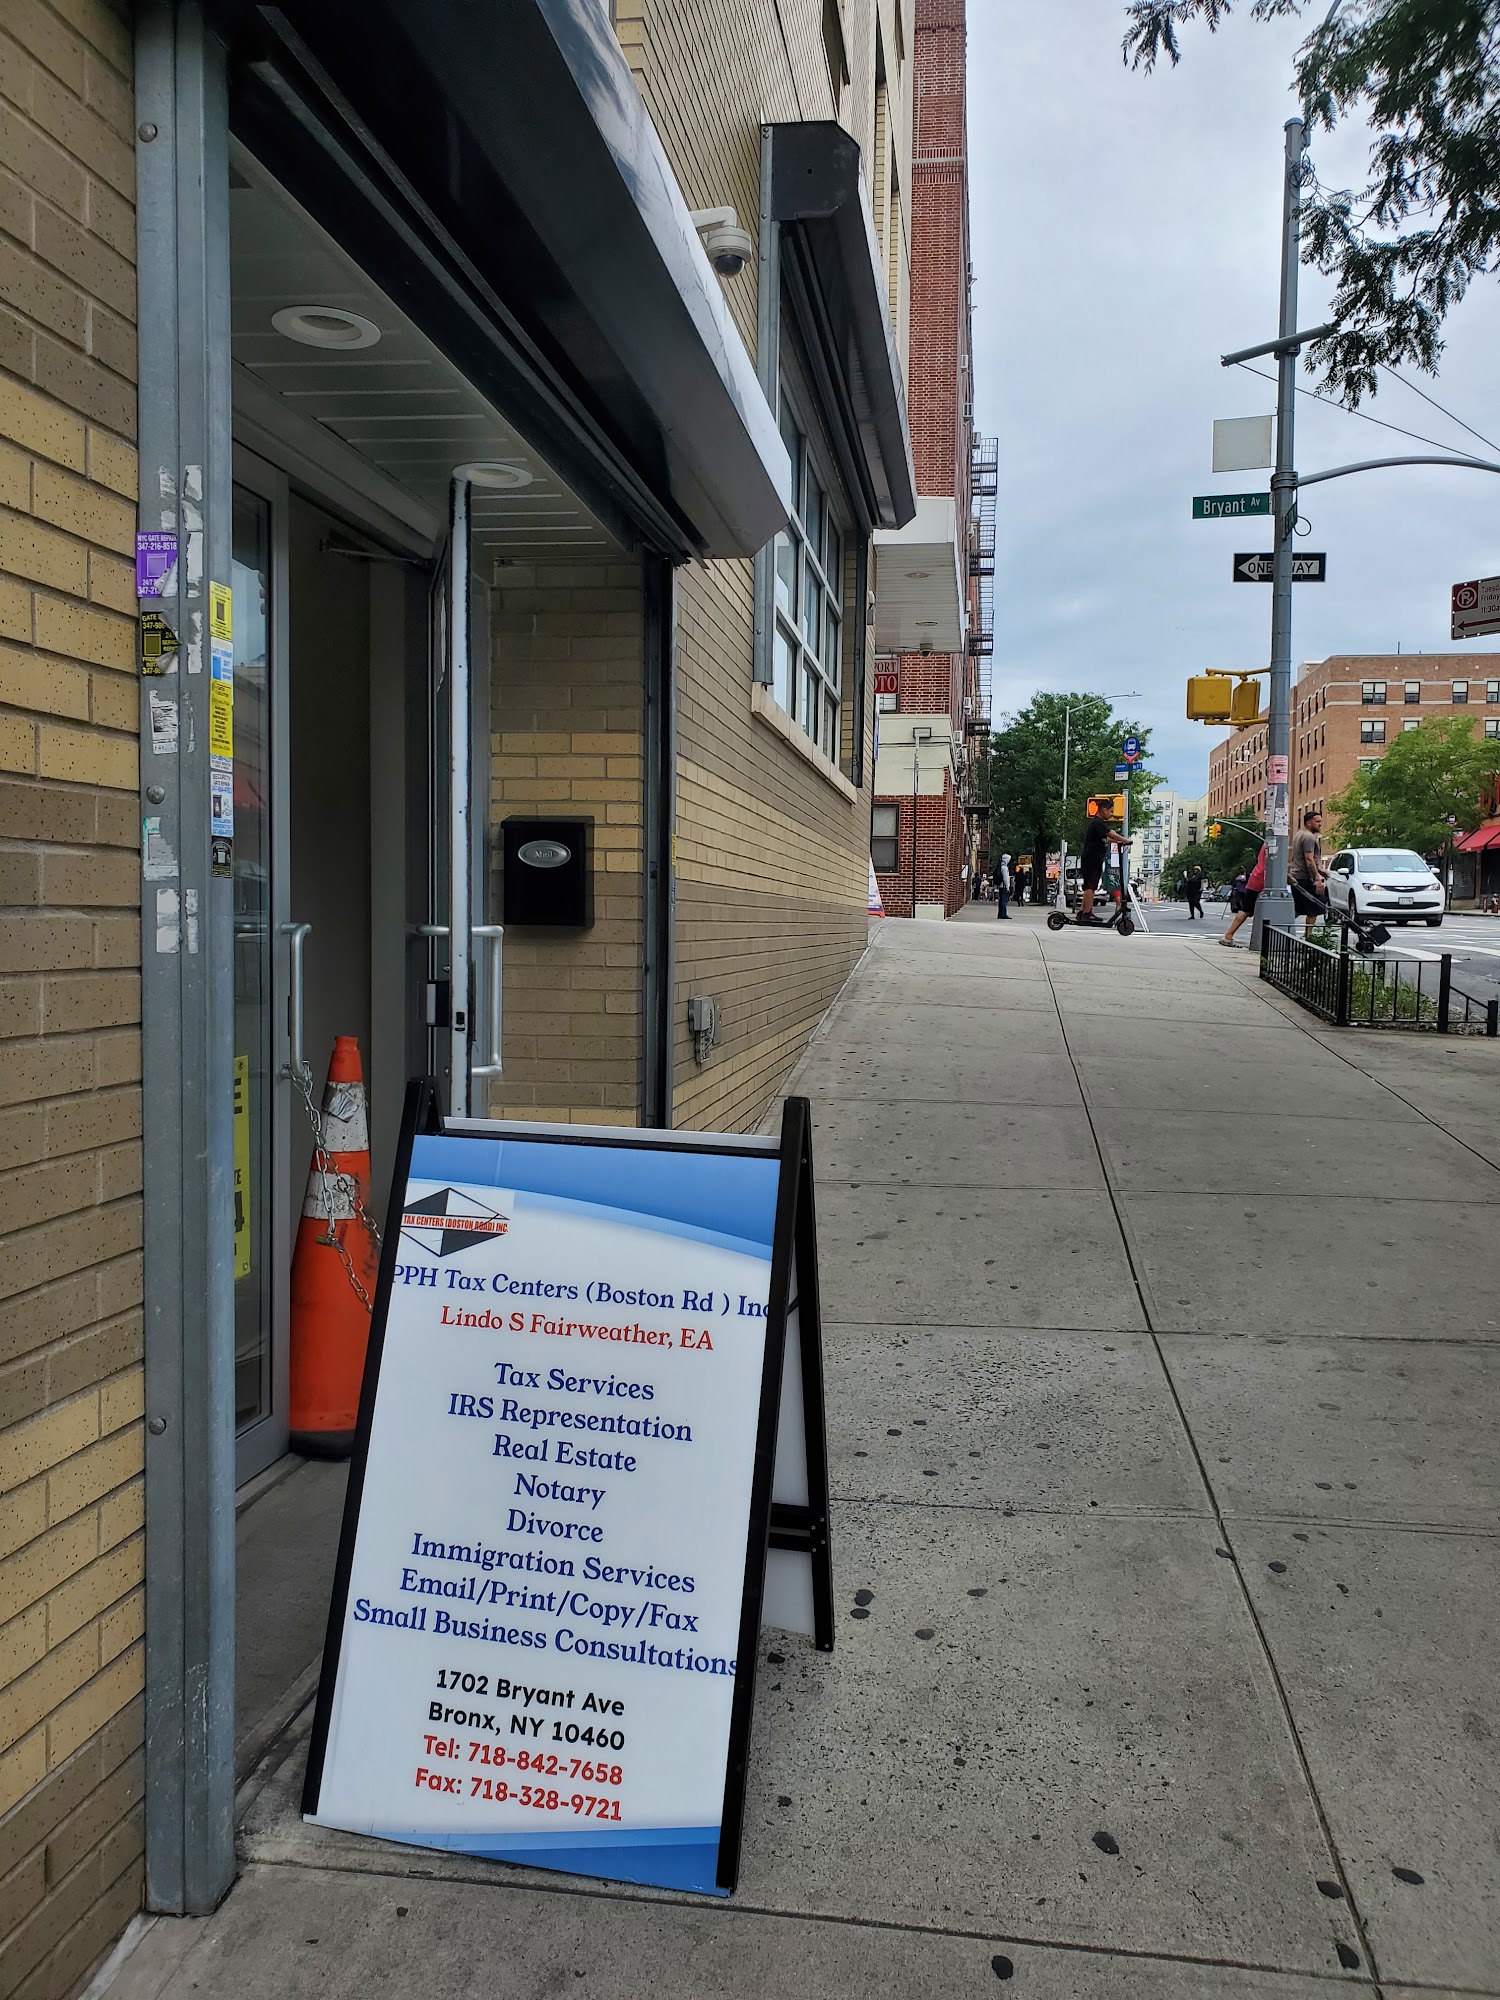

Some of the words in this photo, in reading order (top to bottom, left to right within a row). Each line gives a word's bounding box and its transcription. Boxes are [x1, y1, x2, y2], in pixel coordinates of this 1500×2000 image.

[1203, 497, 1246, 517] Bryant
[1250, 496, 1260, 507] Av
[137, 542, 177, 550] 347-216-8518
[142, 614, 157, 622] GATE
[1481, 594, 1500, 602] Friday
[403, 1214, 416, 1225] TAX
[416, 1216, 444, 1227] CENTERS
[445, 1217, 474, 1230] (BOSTON
[474, 1220, 495, 1232] ROAD)
[495, 1222, 509, 1233] INC.
[445, 1269, 486, 1291] Tax
[493, 1274, 578, 1299] Centers
[587, 1281, 674, 1308] (Boston
[681, 1290, 713, 1312] Rd
[441, 1306, 502, 1329] Lindo
[509, 1313, 524, 1331] S
[530, 1314, 672, 1349] Fairweather,
[679, 1328, 713, 1350] EA
[494, 1362, 540, 1388] Tax
[547, 1369, 654, 1400] Services
[448, 1393, 493, 1418] IRS
[500, 1399, 692, 1441] Representation
[492, 1434, 548, 1461] Real
[555, 1441, 636, 1472] Estate
[514, 1473, 606, 1510] Notary
[506, 1509, 603, 1542] Divorce
[411, 1533, 575, 1576] Immigration
[583, 1557, 694, 1593] Services
[399, 1567, 699, 1633] Email/Print/Copy/Fax
[354, 1599, 426, 1631] Small
[433, 1610, 546, 1649] Business
[554, 1628, 737, 1677] Consultations
[437, 1670, 488, 1695] 1702
[497, 1678, 575, 1708] Bryant
[581, 1693, 624, 1716] Ave
[429, 1702, 500, 1736] Bronx,
[510, 1715, 545, 1737] NY
[552, 1722, 624, 1750] 10460
[424, 1735, 460, 1759] Tel:
[469, 1742, 622, 1785] 718-842-7658
[416, 1768, 462, 1794] Fax:
[471, 1777, 621, 1821] 718-328-9721
